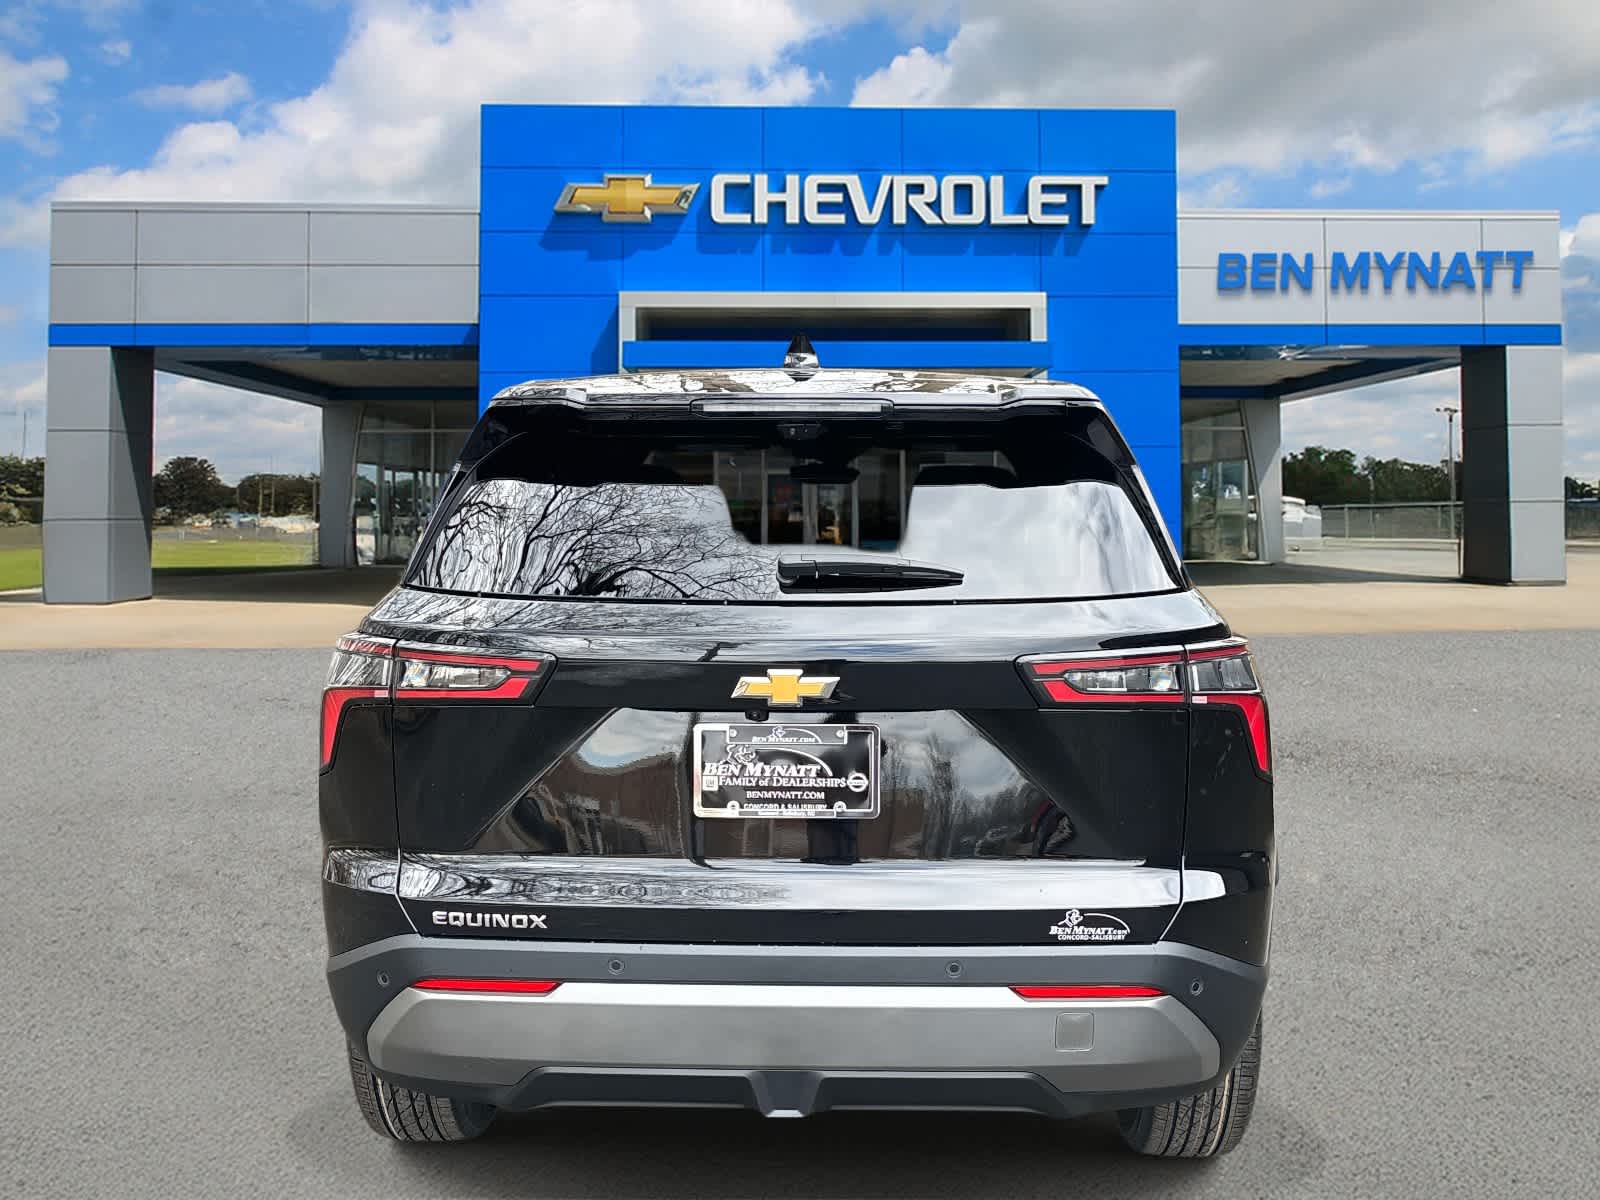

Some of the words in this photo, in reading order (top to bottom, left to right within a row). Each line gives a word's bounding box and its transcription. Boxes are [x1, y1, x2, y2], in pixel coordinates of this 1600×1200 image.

[710, 173, 1109, 226] CHEVROLET
[1217, 252, 1313, 290] BEN
[1330, 250, 1534, 290] MYNATT
[702, 762, 741, 777] BEN
[743, 762, 821, 777] MYNATT
[719, 776, 758, 787] FAMILY
[773, 776, 846, 787] DEALERSHIPS
[746, 790, 825, 800] BENMYNATT.COM
[432, 910, 548, 929] EQUINOX
